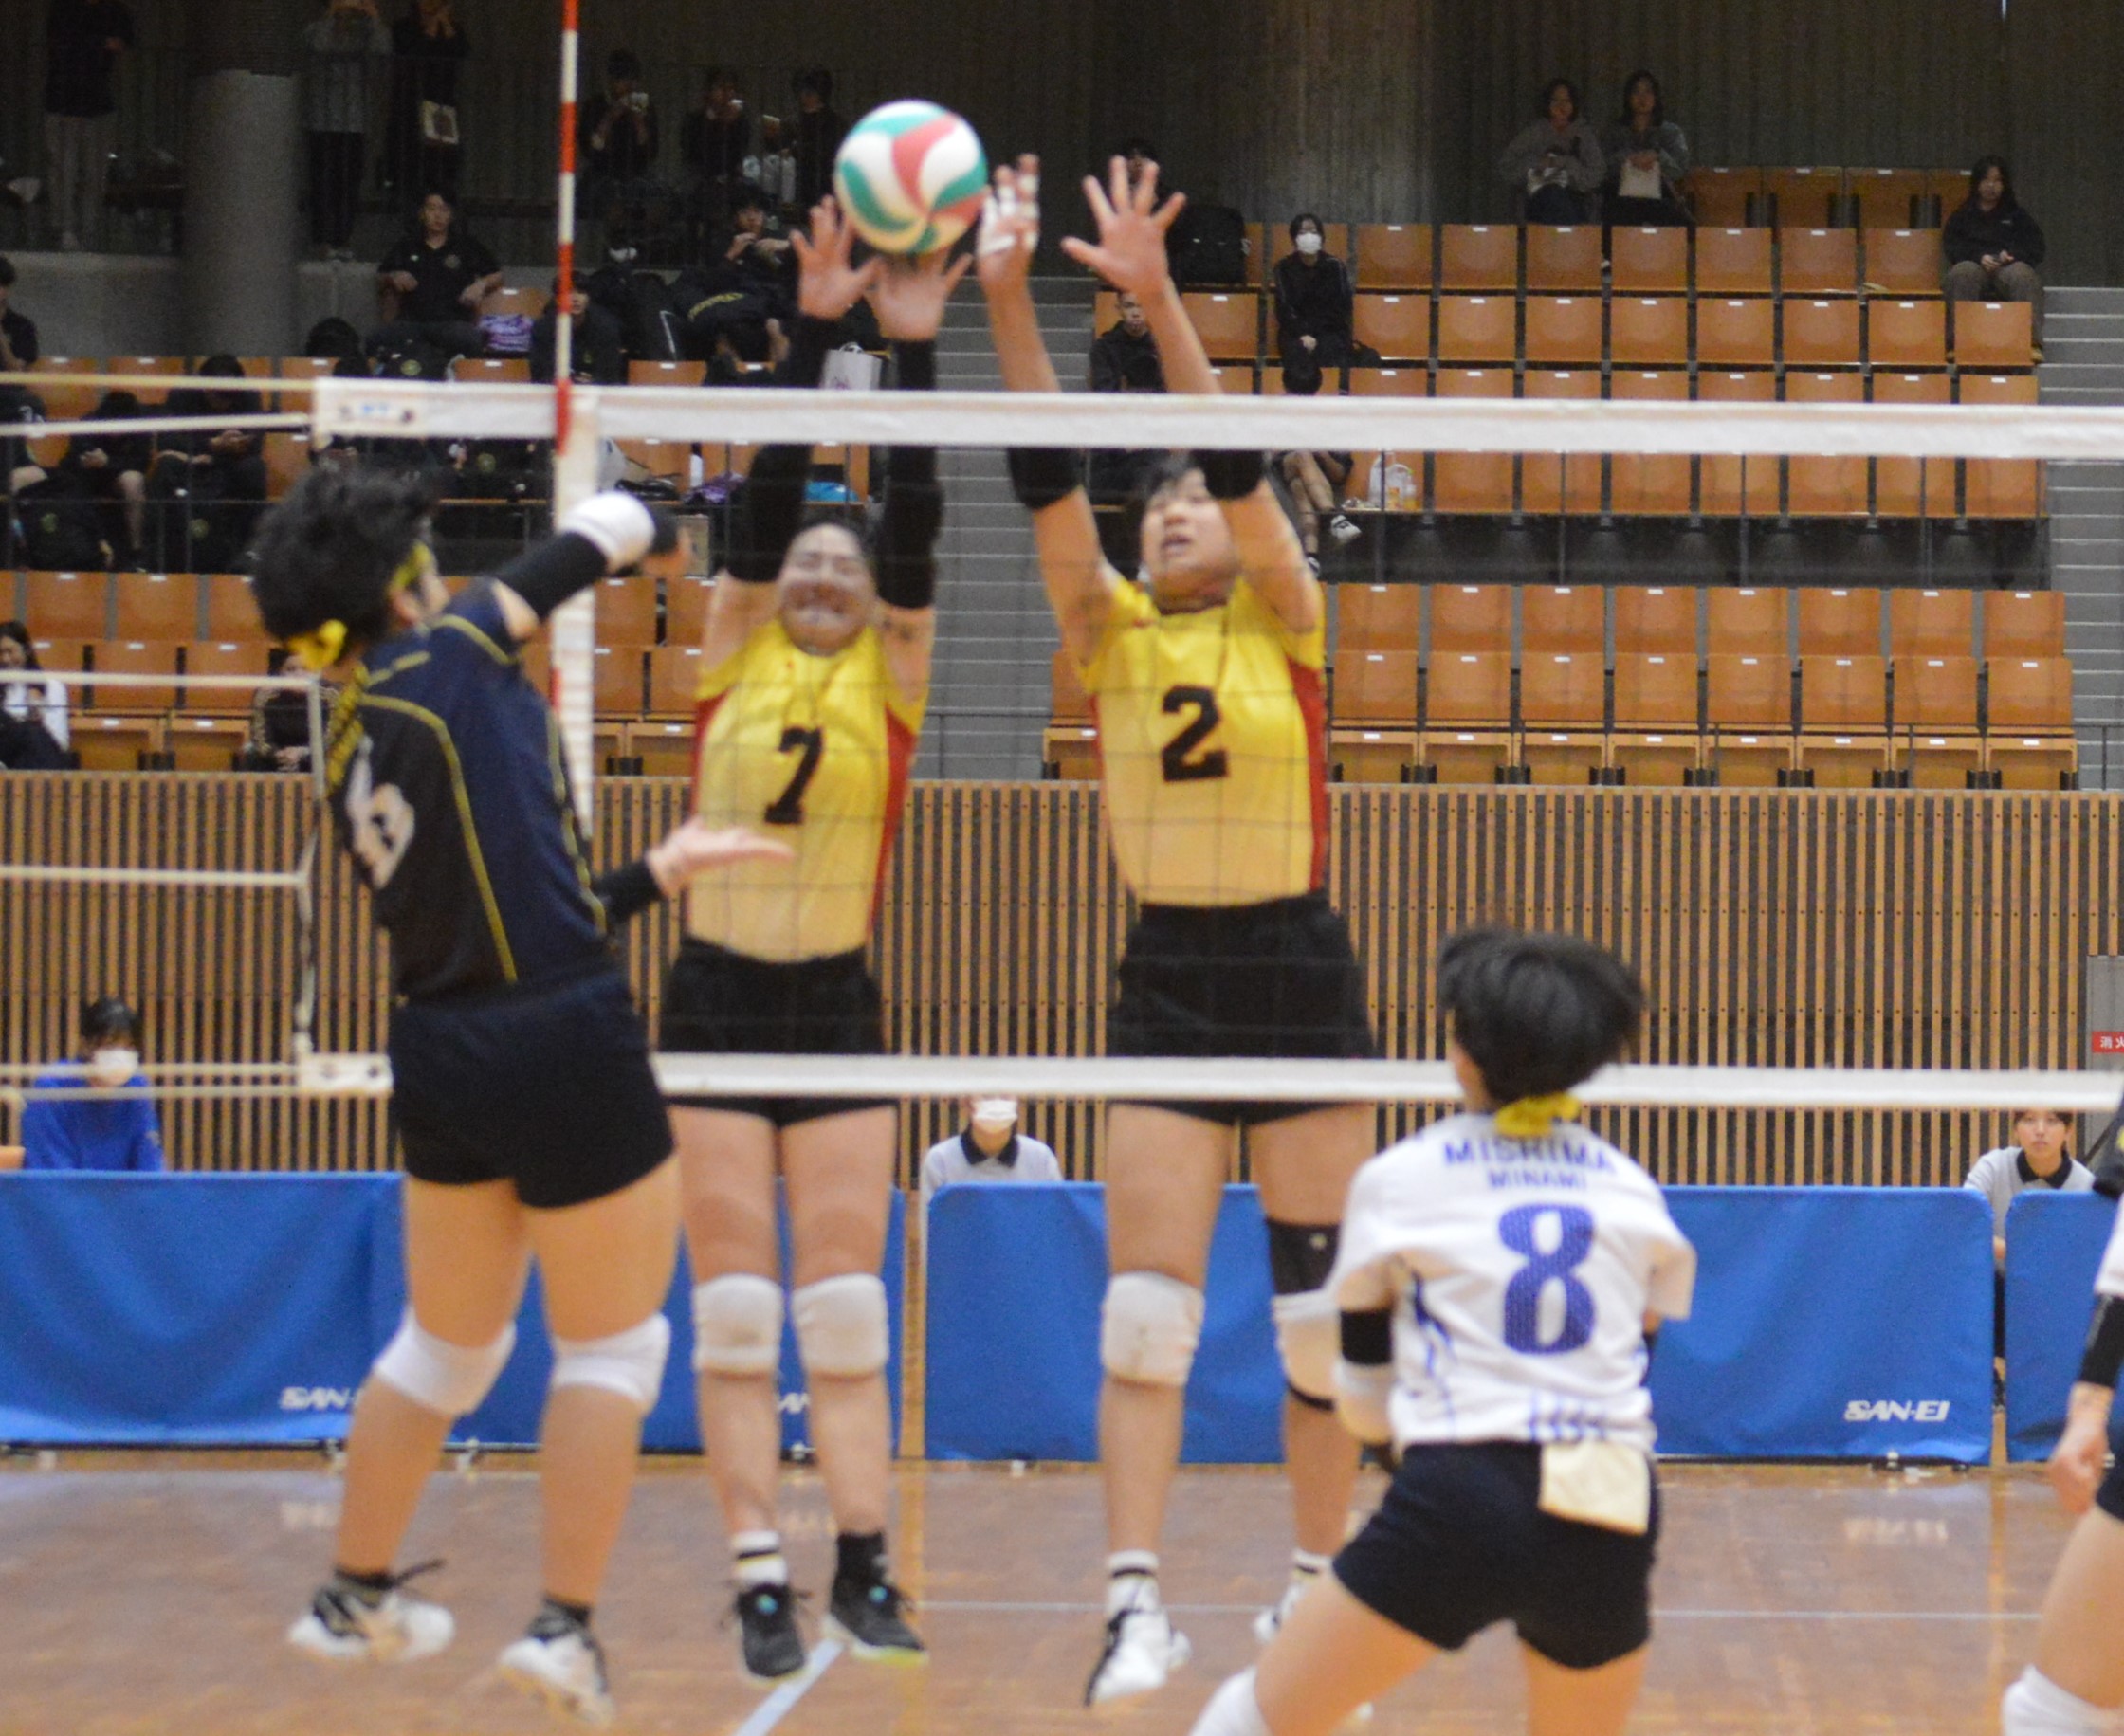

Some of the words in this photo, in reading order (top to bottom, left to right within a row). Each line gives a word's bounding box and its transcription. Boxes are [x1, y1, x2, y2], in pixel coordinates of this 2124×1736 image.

[1162, 684, 1229, 781] 2
[763, 725, 824, 825] 7
[1443, 1138, 1616, 1174] MISHIMA
[1487, 1168, 1587, 1189] MINAMI
[1498, 1202, 1596, 1356] 8
[280, 1386, 357, 1411] SAN-
[1844, 1399, 1950, 1422] SAN-EI
